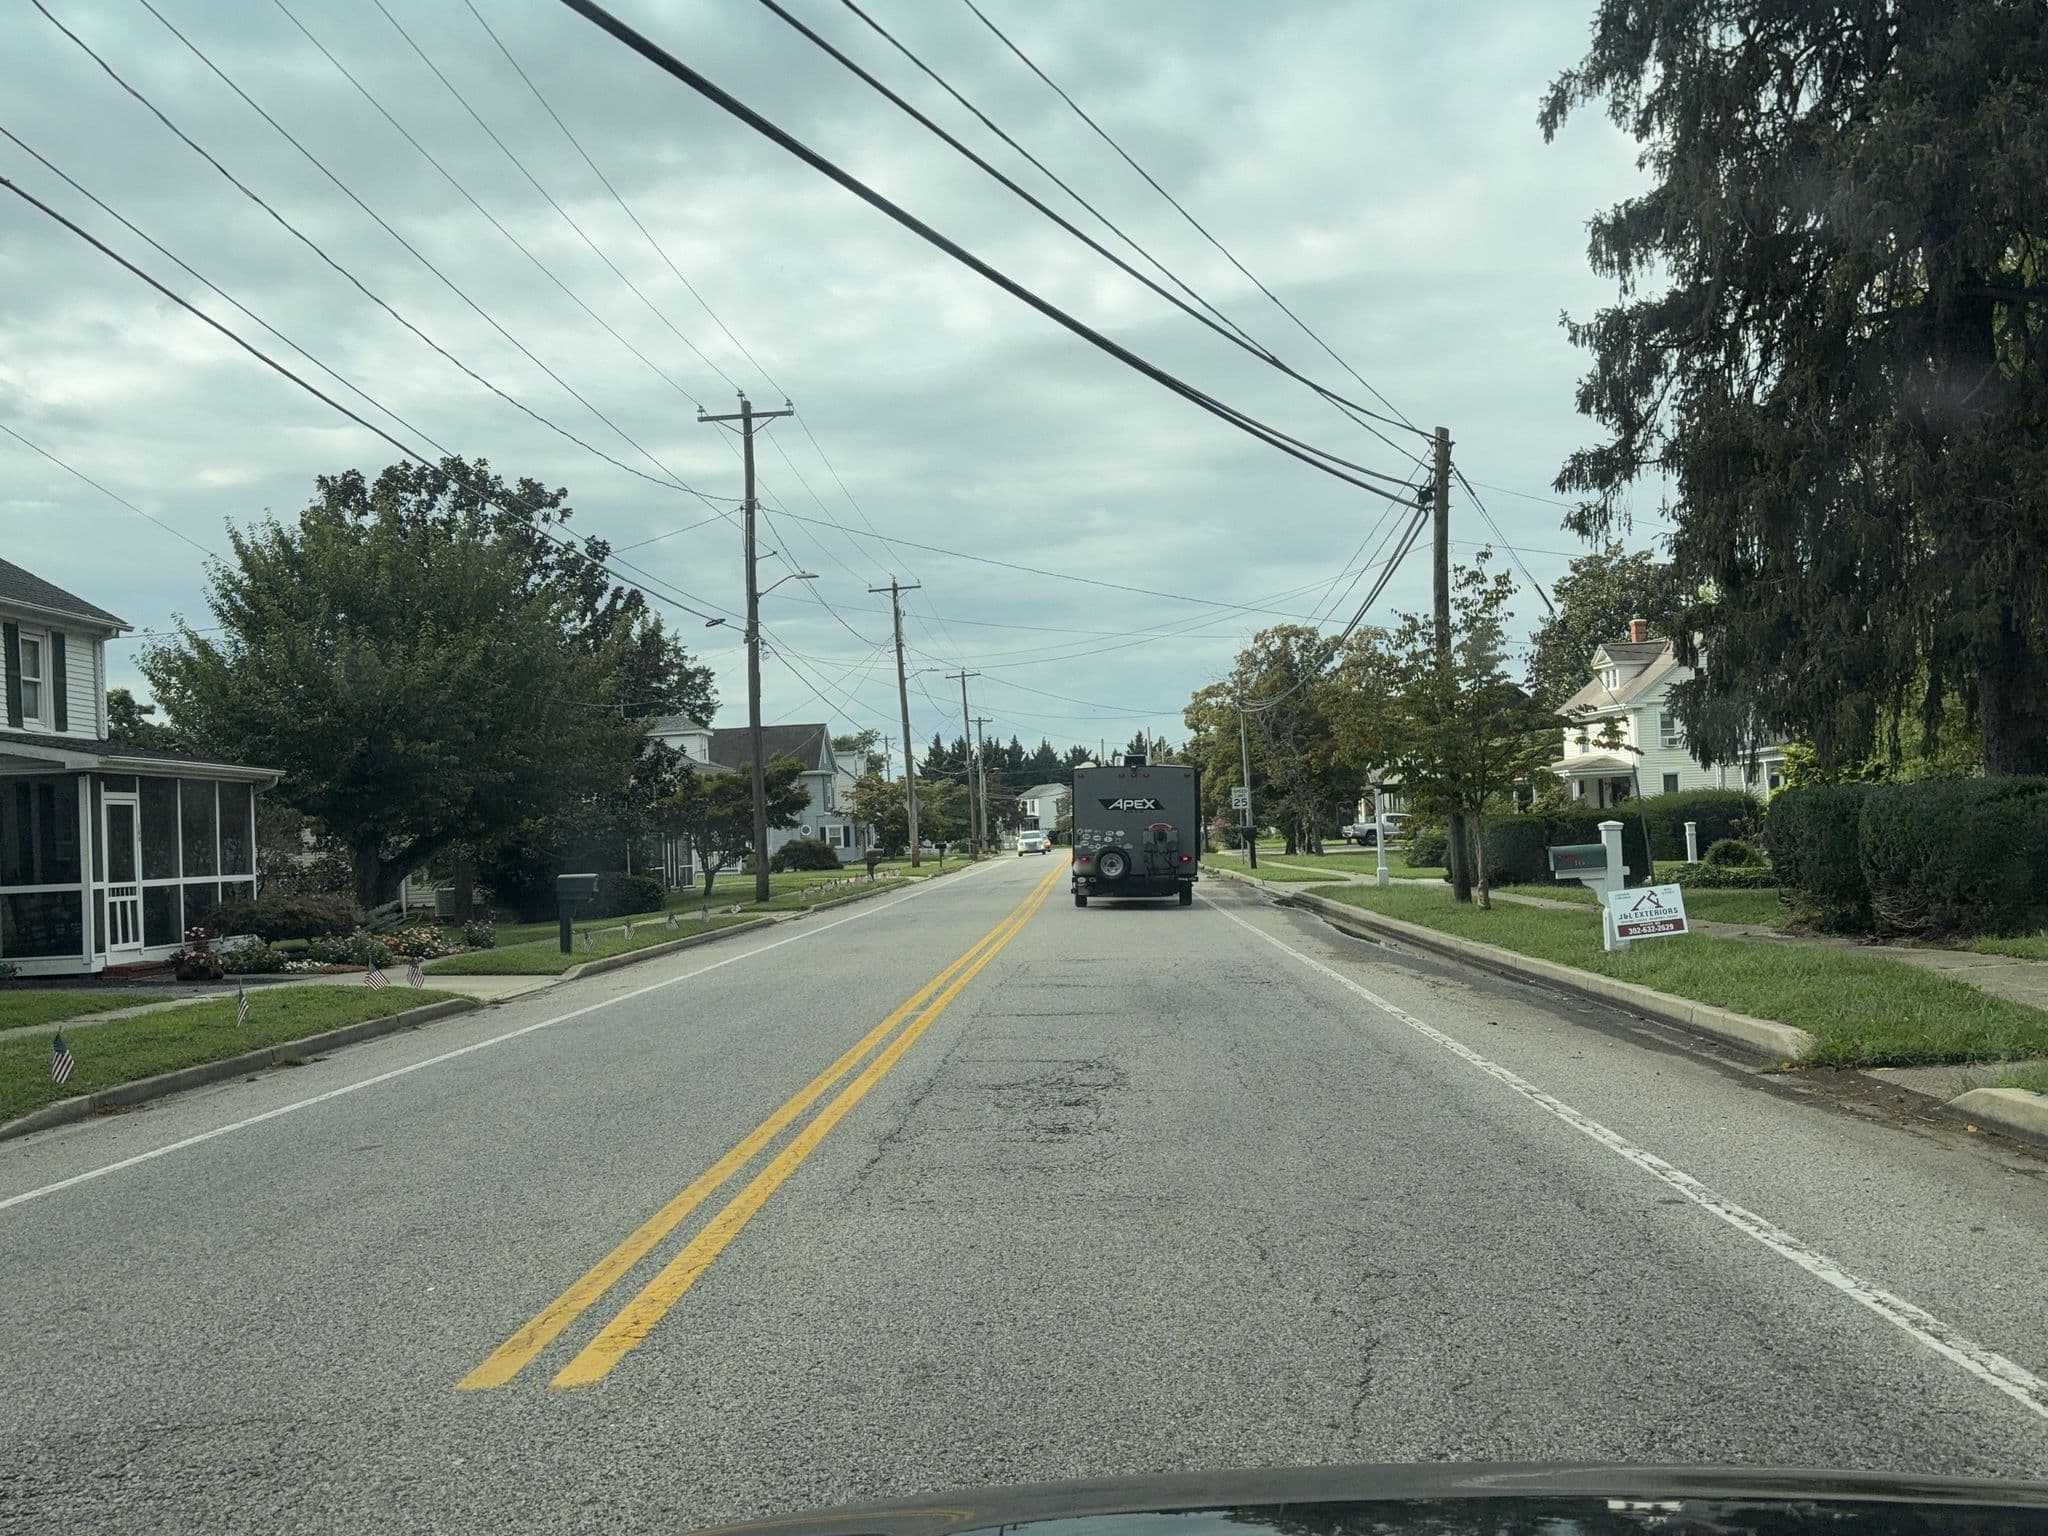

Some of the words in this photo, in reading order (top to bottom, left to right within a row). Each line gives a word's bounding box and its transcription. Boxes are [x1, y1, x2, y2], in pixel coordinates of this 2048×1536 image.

[1108, 798, 1155, 810] APEX
[1234, 798, 1248, 807] 25
[1634, 907, 1679, 919] EXTERIORS
